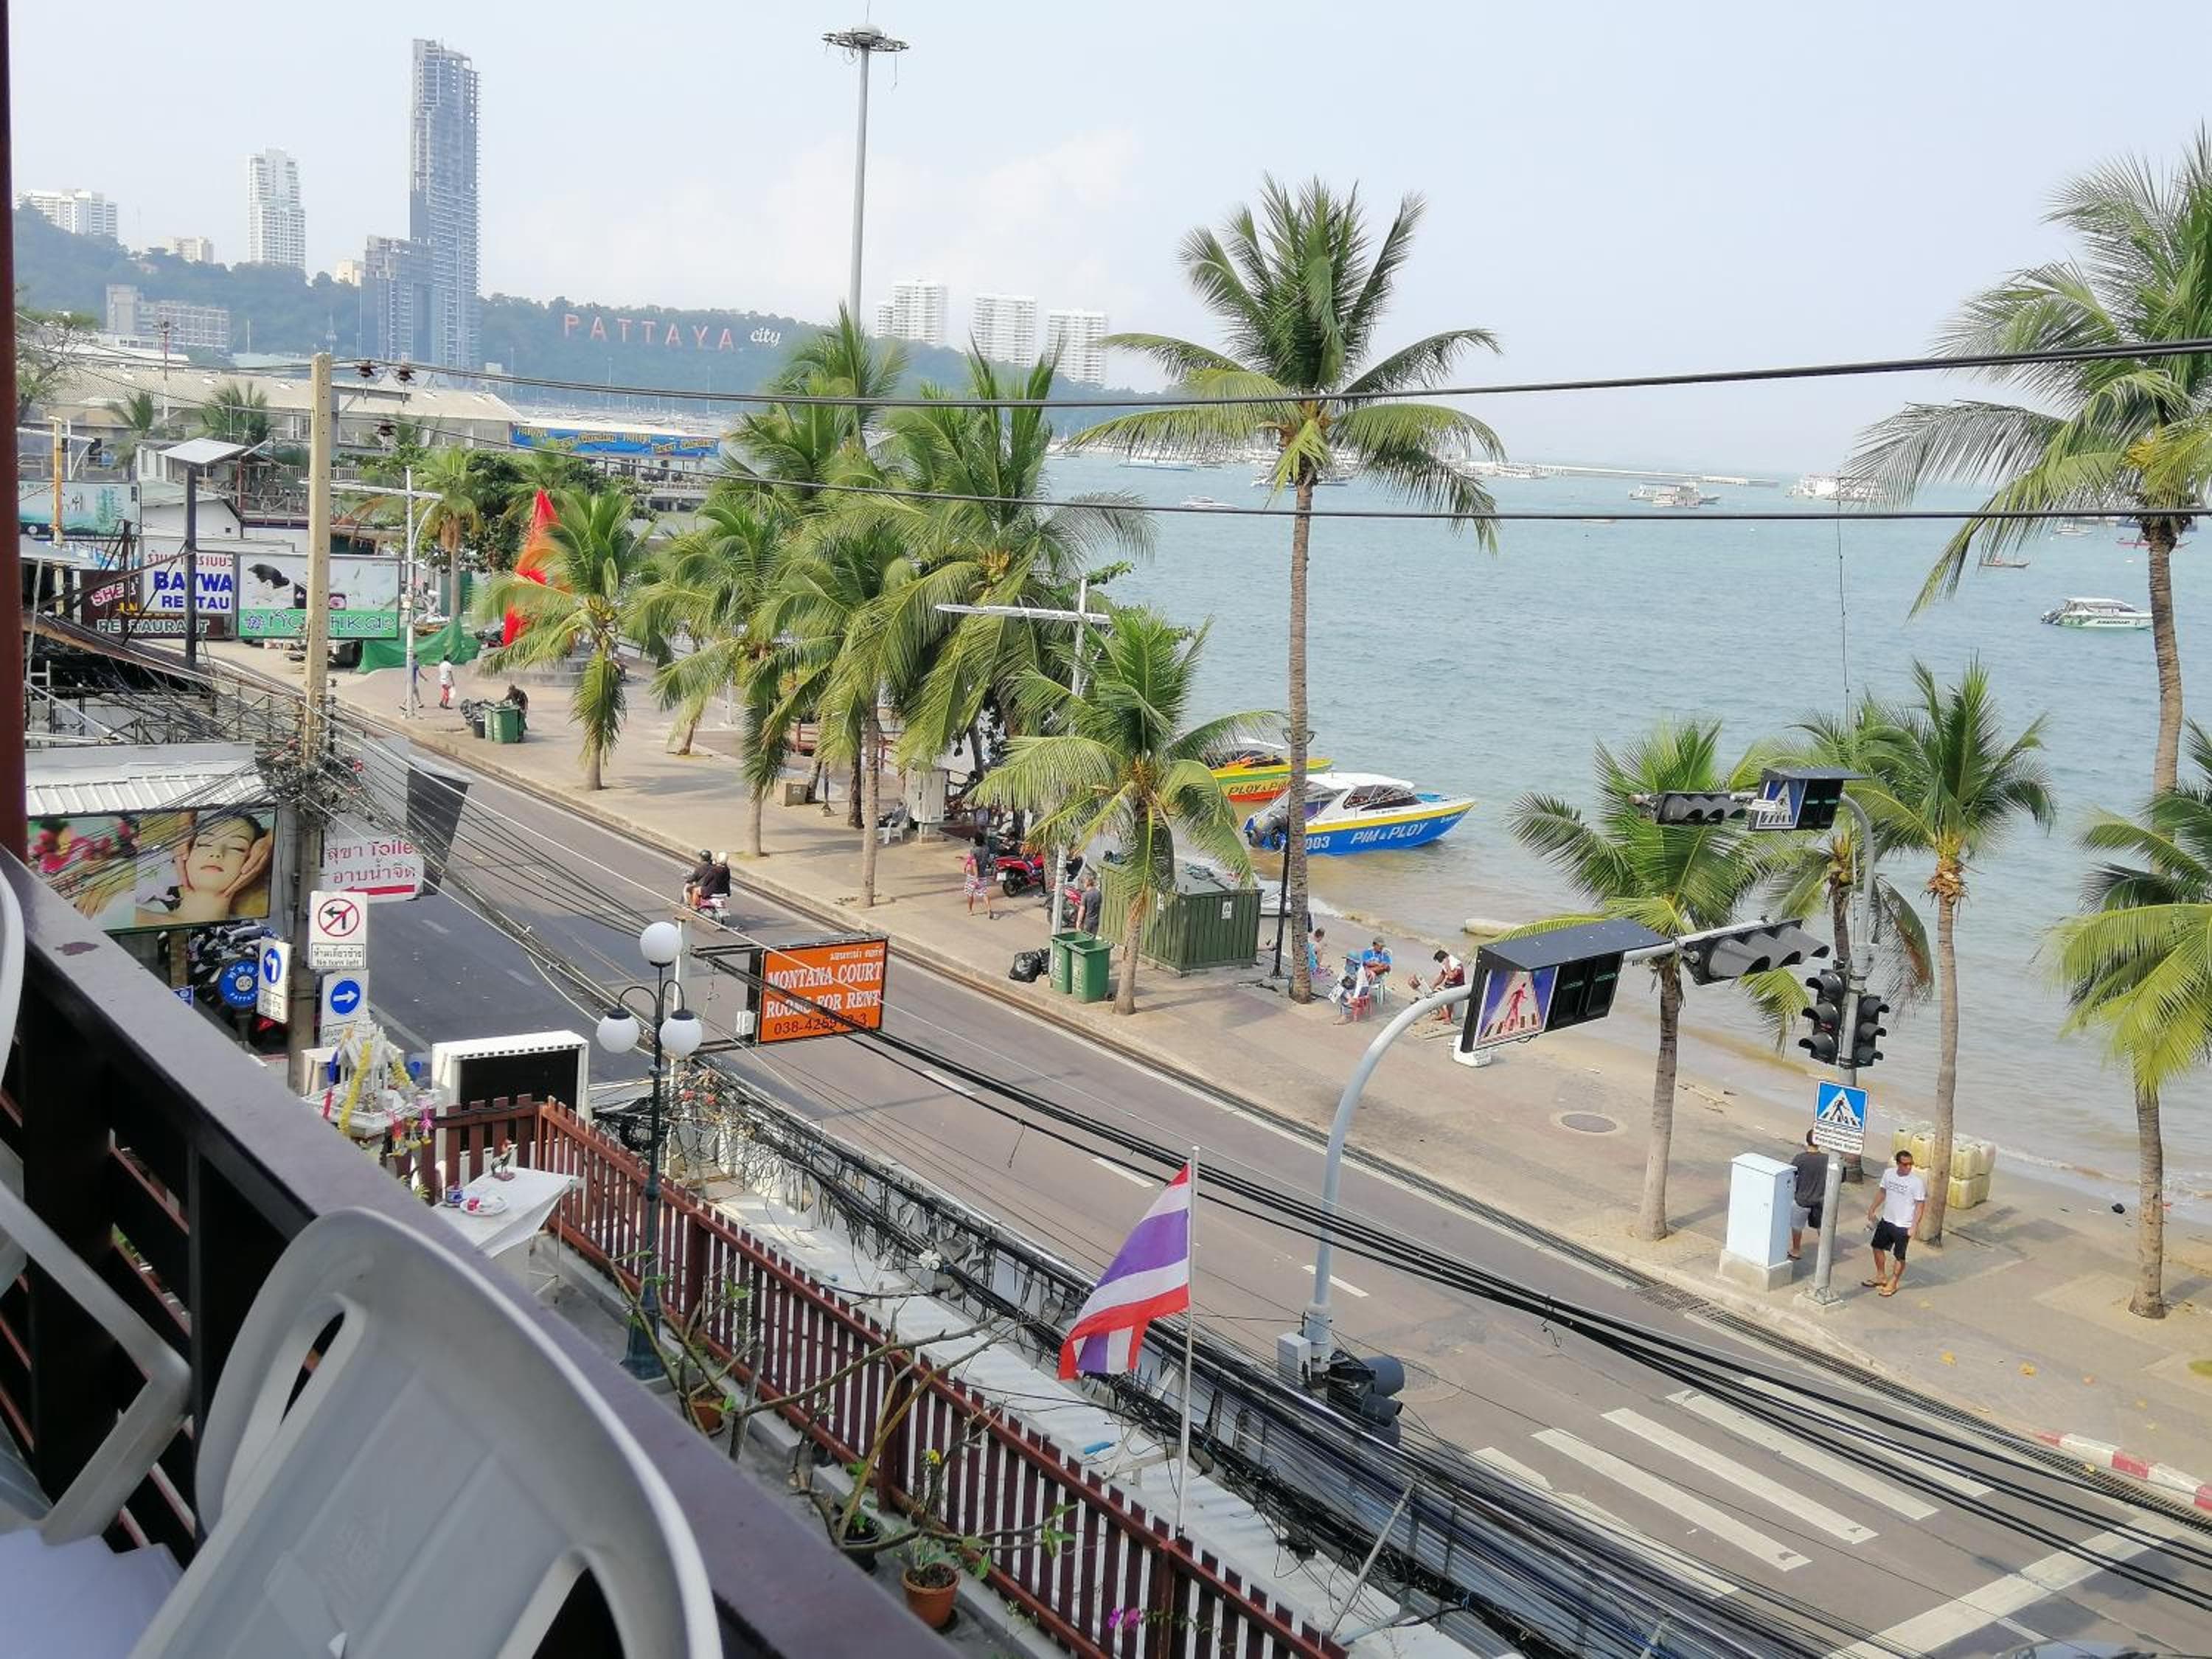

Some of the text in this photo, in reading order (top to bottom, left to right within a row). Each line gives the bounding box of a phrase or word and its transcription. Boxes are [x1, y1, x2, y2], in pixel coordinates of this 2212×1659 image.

[565, 313, 782, 353] PATTAYA city
[161, 595, 230, 611] RETAU
[97, 617, 210, 634] RETAURAT
[1350, 830, 1379, 844] PIM
[1387, 821, 1428, 841] PLOY
[371, 839, 414, 856] Toile
[768, 961, 883, 989] MONTANA COURT
[846, 990, 881, 1009] RENT
